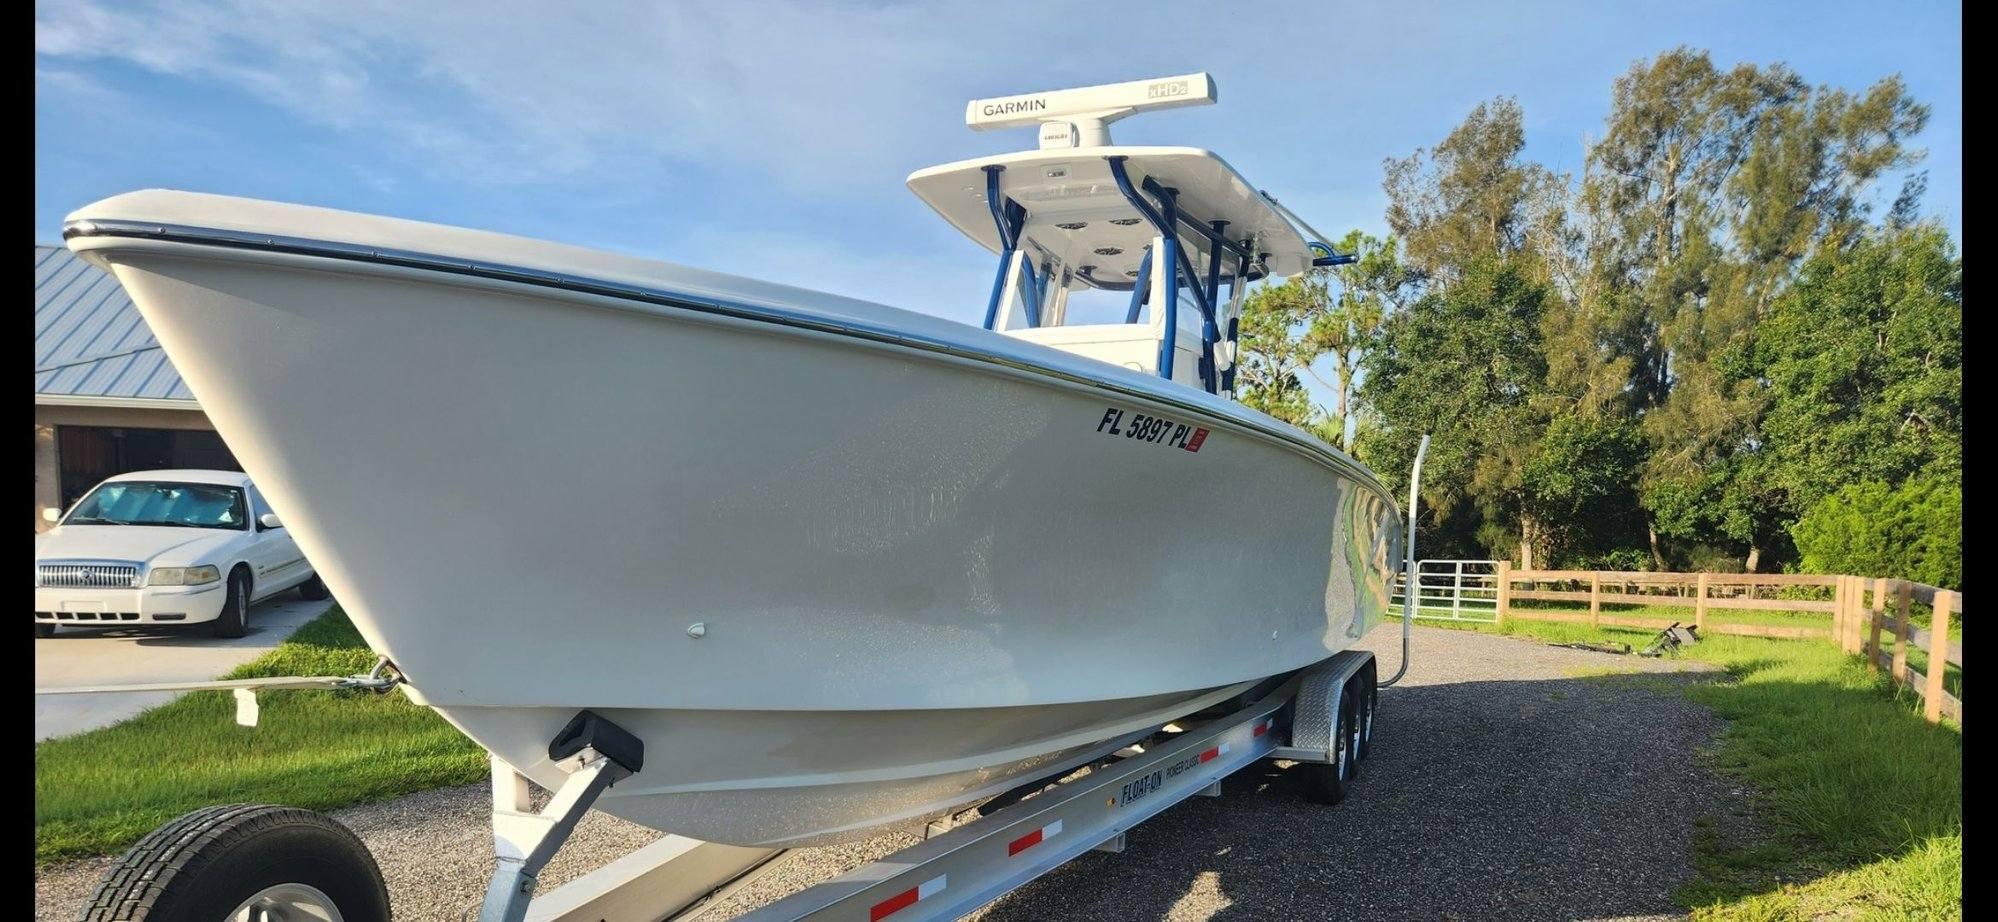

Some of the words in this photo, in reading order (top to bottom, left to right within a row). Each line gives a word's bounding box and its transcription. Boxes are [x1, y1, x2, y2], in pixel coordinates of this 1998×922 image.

[983, 98, 1046, 117] GARMIN
[1096, 407, 1124, 436] FL
[1126, 414, 1174, 444] 5897
[1168, 424, 1192, 450] PL
[1120, 769, 1163, 807] FLOAT-ON
